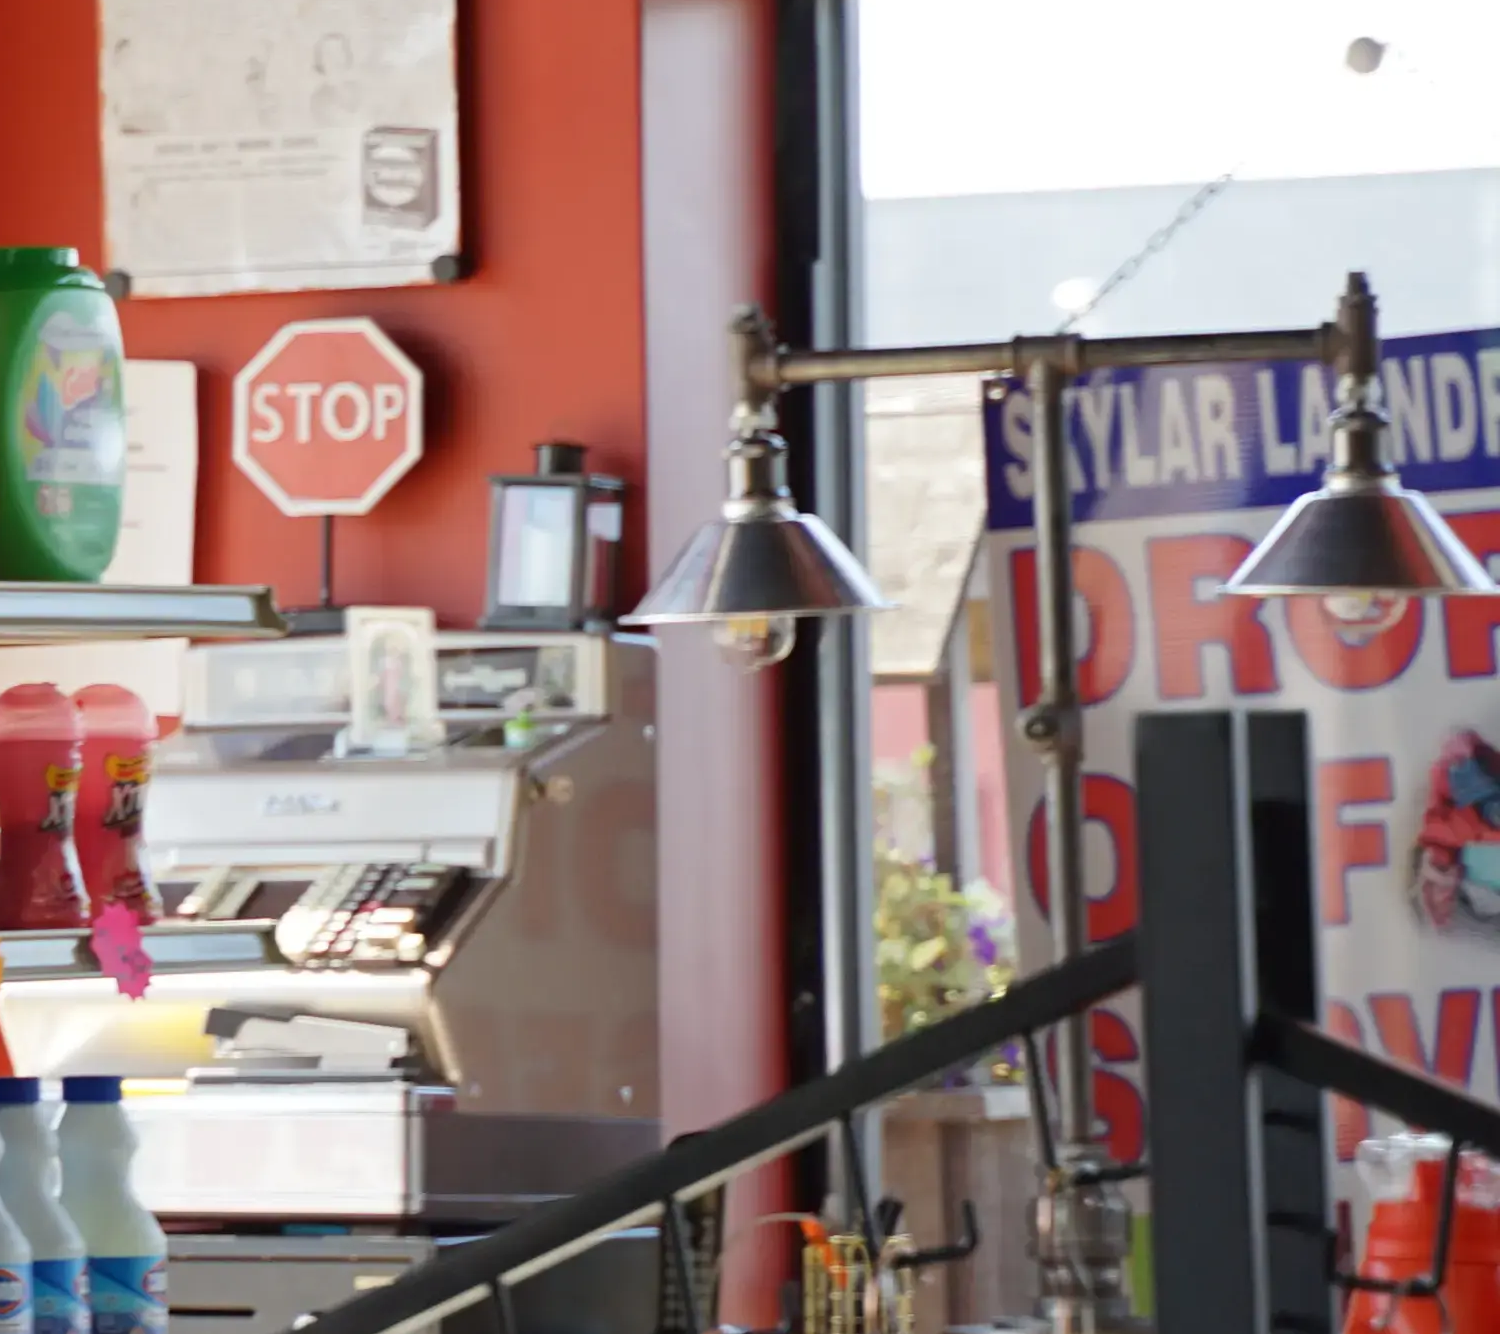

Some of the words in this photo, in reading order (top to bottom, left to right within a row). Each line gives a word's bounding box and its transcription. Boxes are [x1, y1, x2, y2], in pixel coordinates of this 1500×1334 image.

[251, 381, 406, 443] STOP
[1257, 348, 1500, 477] LAND
[42, 788, 75, 832] XT
[1030, 772, 1393, 943] OF
